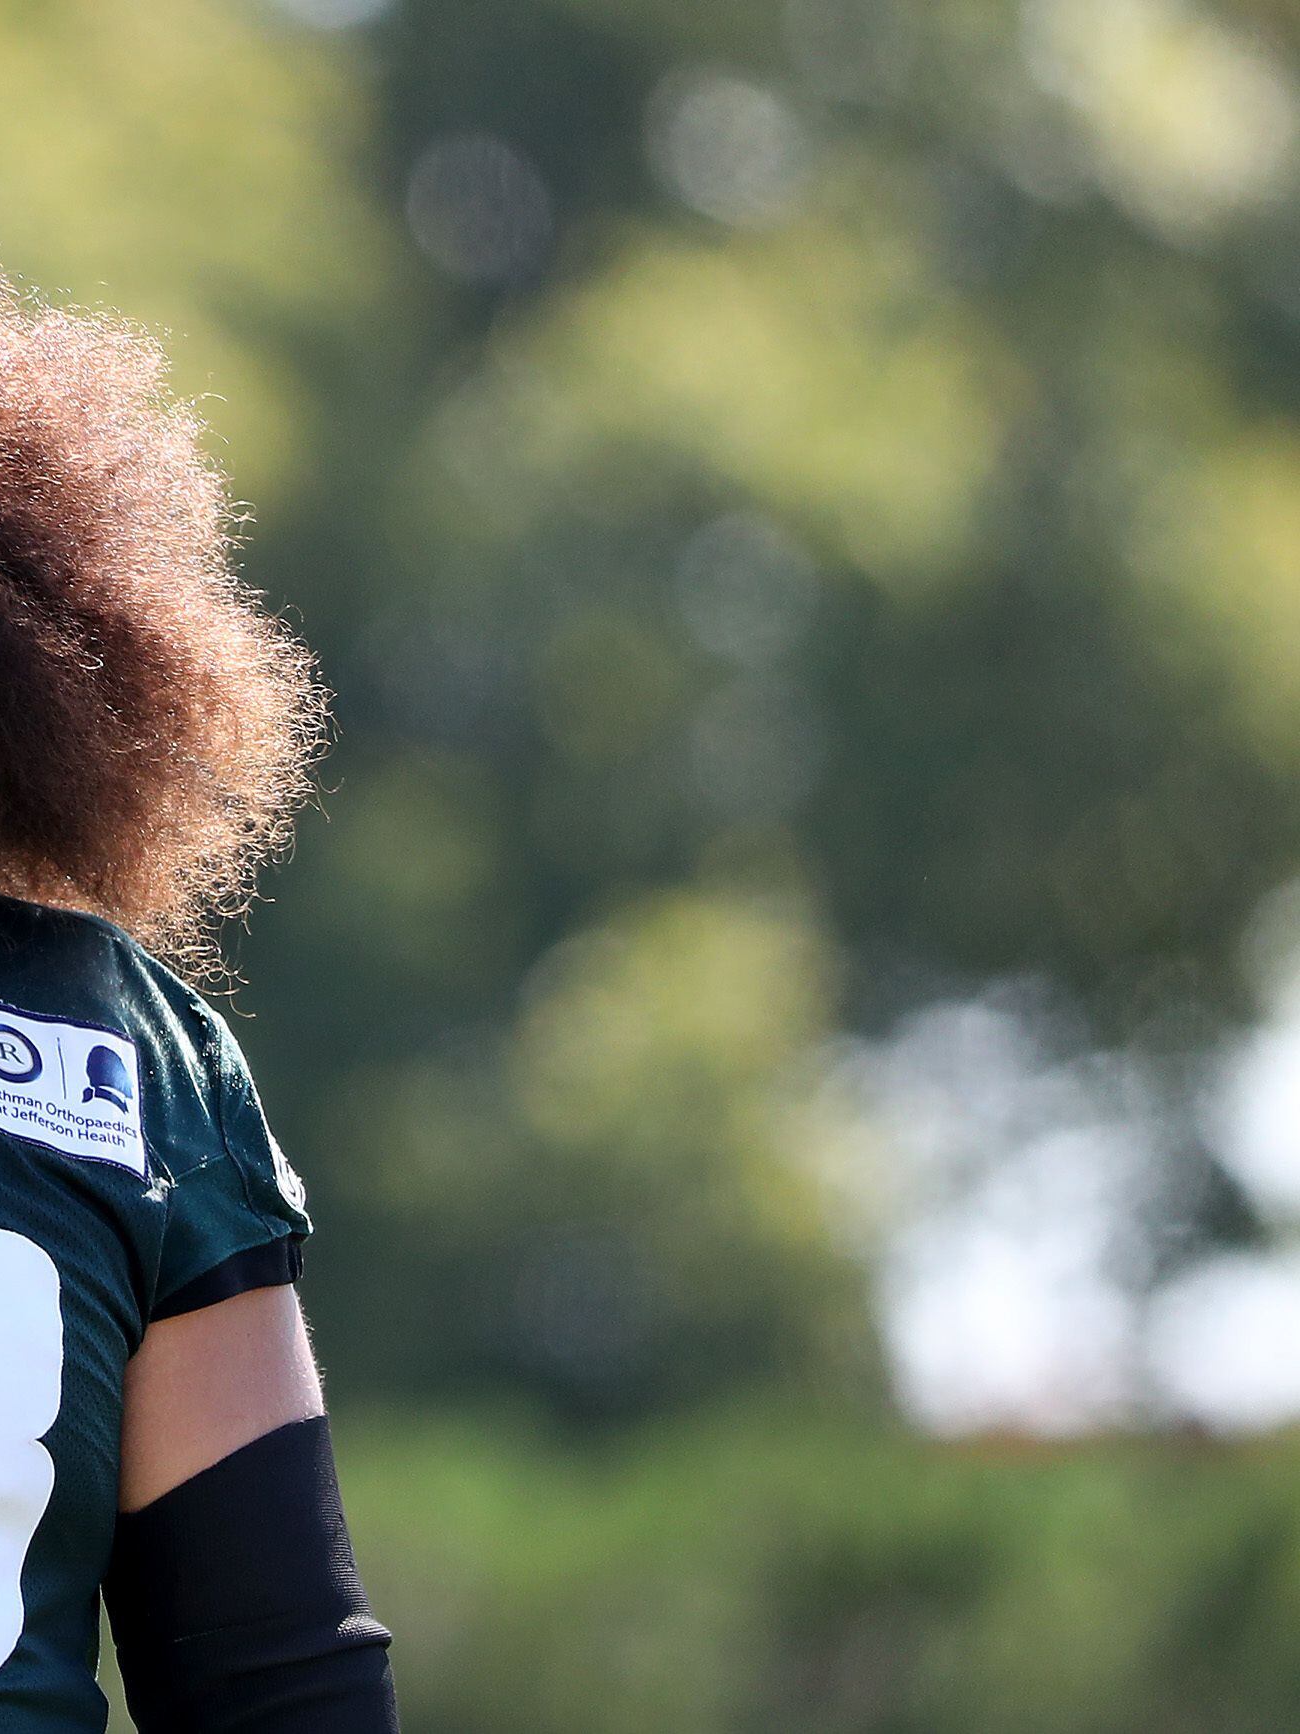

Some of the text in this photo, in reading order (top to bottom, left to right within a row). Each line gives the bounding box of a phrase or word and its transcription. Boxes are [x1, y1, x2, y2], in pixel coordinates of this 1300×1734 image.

[11, 1106, 73, 1138] Jefferson
[78, 1129, 126, 1148] Health
[45, 1102, 138, 1139] Orthopaedics
